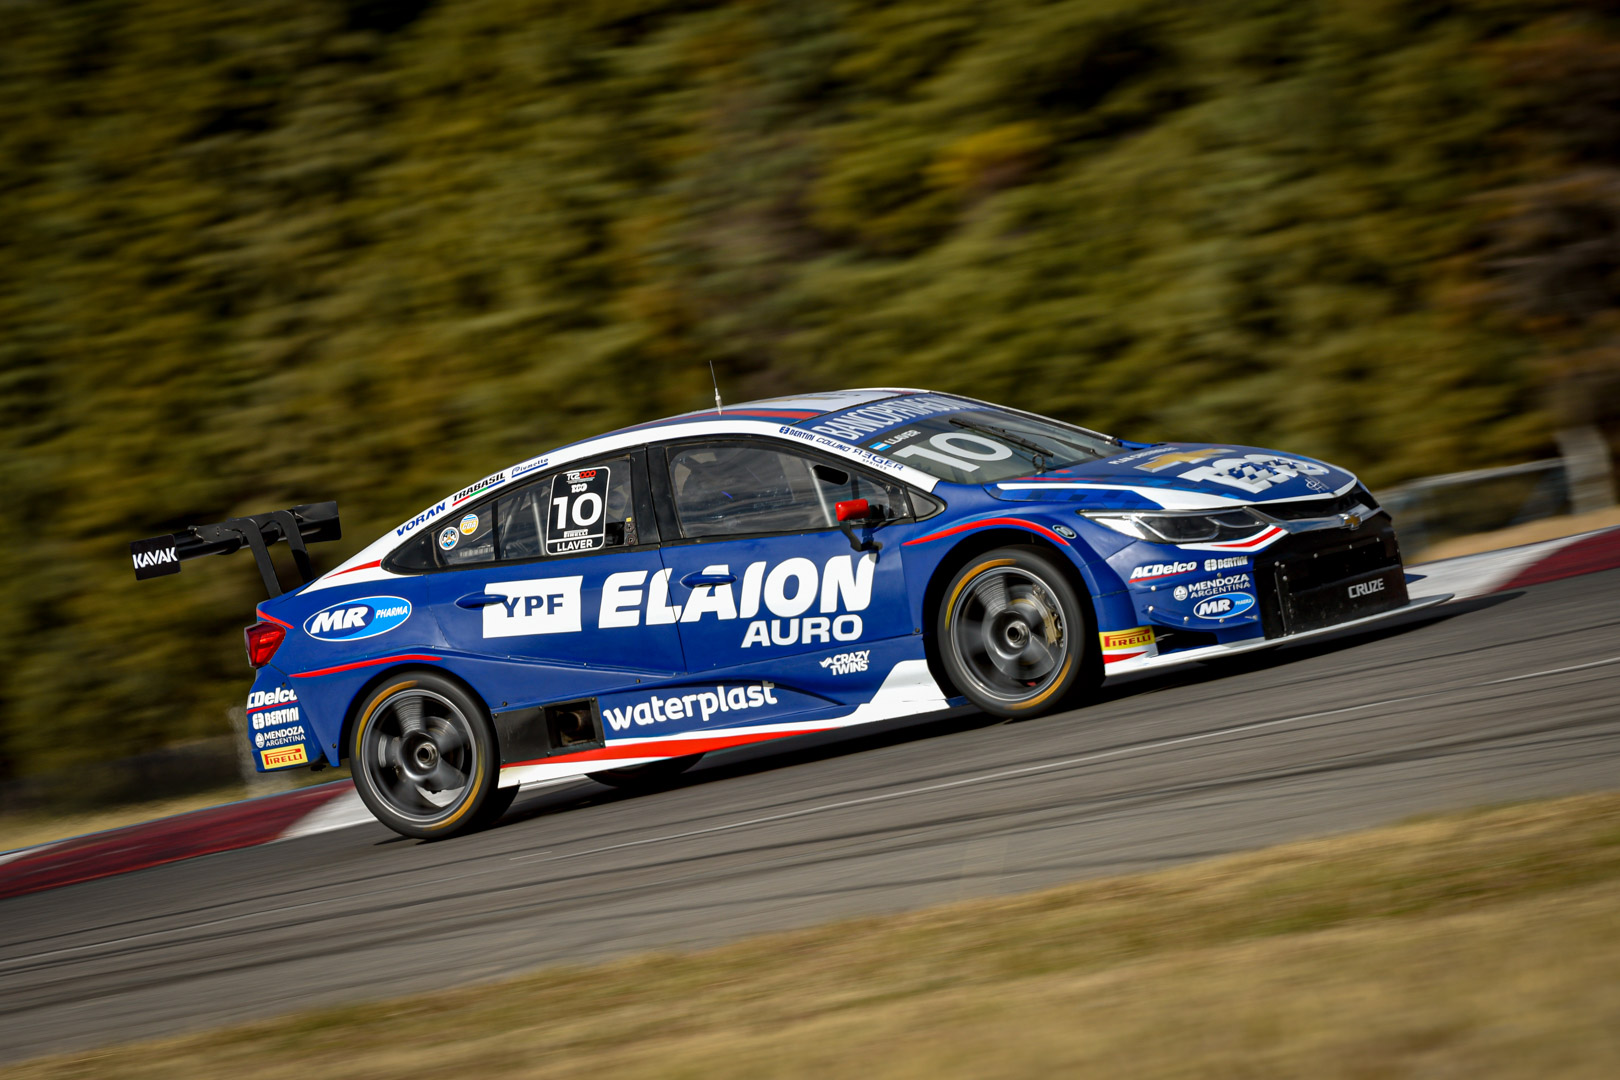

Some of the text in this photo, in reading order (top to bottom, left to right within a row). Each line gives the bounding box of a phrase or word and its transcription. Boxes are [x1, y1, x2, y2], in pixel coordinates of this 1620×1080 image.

[789, 429, 816, 442] BERTINI
[816, 437, 852, 452] COLLINO
[893, 432, 1013, 473] 10
[567, 470, 597, 481] TC2000
[452, 472, 506, 502] TRABASIL
[396, 502, 446, 537] VORAN
[553, 492, 602, 529] 10
[557, 539, 593, 552] LLAVER
[132, 547, 178, 569] KAVAK
[1217, 555, 1249, 570] BERTINI
[1130, 561, 1198, 579] ACDelco
[598, 552, 878, 630] ELAION
[1188, 573, 1250, 592] MENDOZA
[1190, 581, 1251, 599] ARGENTINA
[1348, 578, 1385, 599] CRUZE
[501, 593, 564, 618] YPF
[1198, 599, 1232, 616] MR
[310, 606, 408, 634] MR PHARMA
[741, 614, 863, 649] AURO
[1104, 629, 1151, 648] PIRELLI
[833, 650, 870, 665] CRAZY
[830, 660, 868, 676] TWINS
[602, 680, 778, 731] waterplast
[264, 706, 300, 726] BERTINI
[264, 726, 305, 741] MENDOZA
[266, 734, 306, 748] ARGENTINA
[264, 748, 303, 766] PIRELLI
